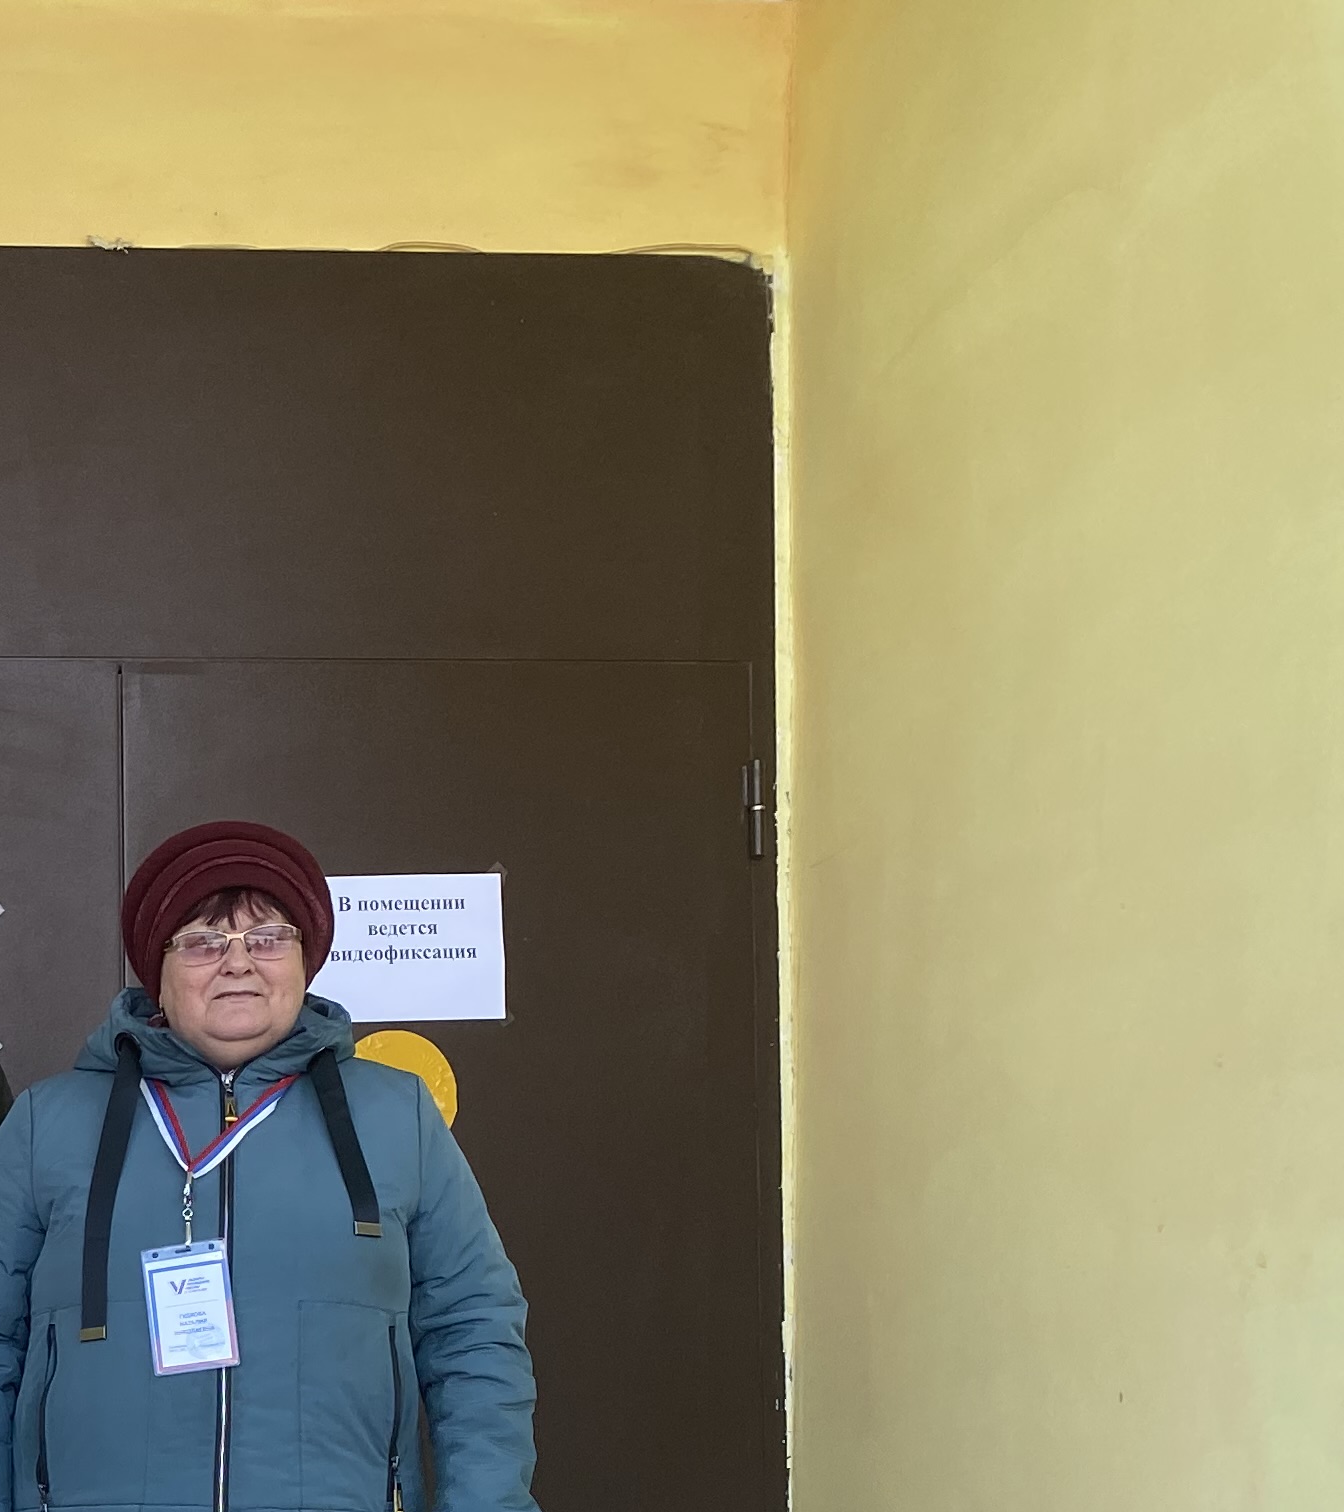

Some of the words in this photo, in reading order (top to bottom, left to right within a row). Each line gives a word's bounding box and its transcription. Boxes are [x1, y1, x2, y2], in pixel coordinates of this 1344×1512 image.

[338, 896, 352, 912] В
[358, 897, 466, 913] помещении
[368, 922, 438, 938] ведется
[330, 944, 478, 964] видеофиксация
